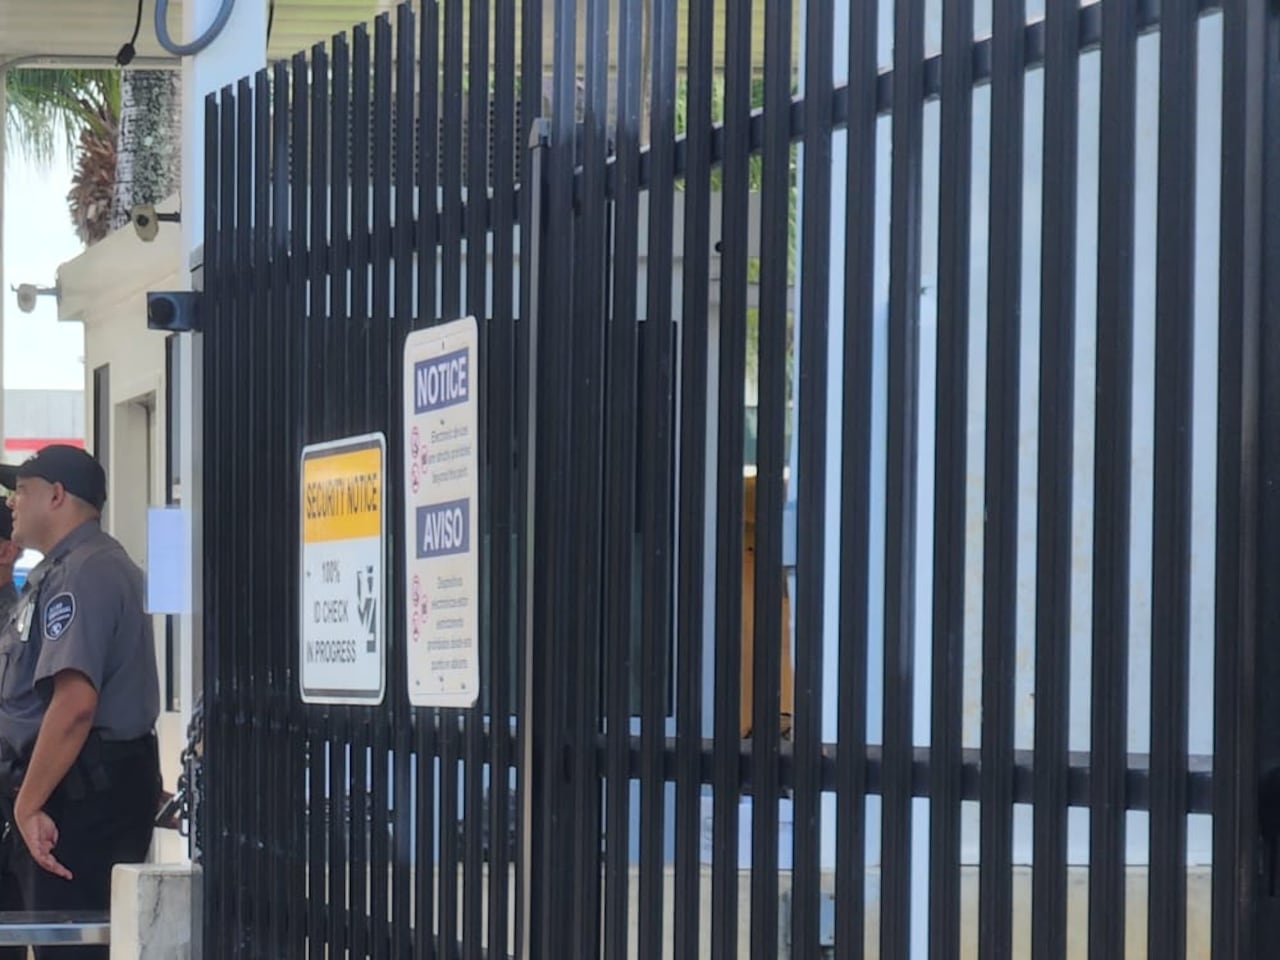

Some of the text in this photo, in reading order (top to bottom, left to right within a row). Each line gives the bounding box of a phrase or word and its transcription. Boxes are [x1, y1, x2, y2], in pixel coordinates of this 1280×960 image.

[417, 356, 467, 407] NOTICE
[306, 472, 378, 519] SECURITY NOTICE
[423, 507, 463, 552] AVISO
[322, 560, 341, 584] 100%
[313, 600, 349, 623] ID CHECK
[306, 640, 356, 664] IN PROGRESS
